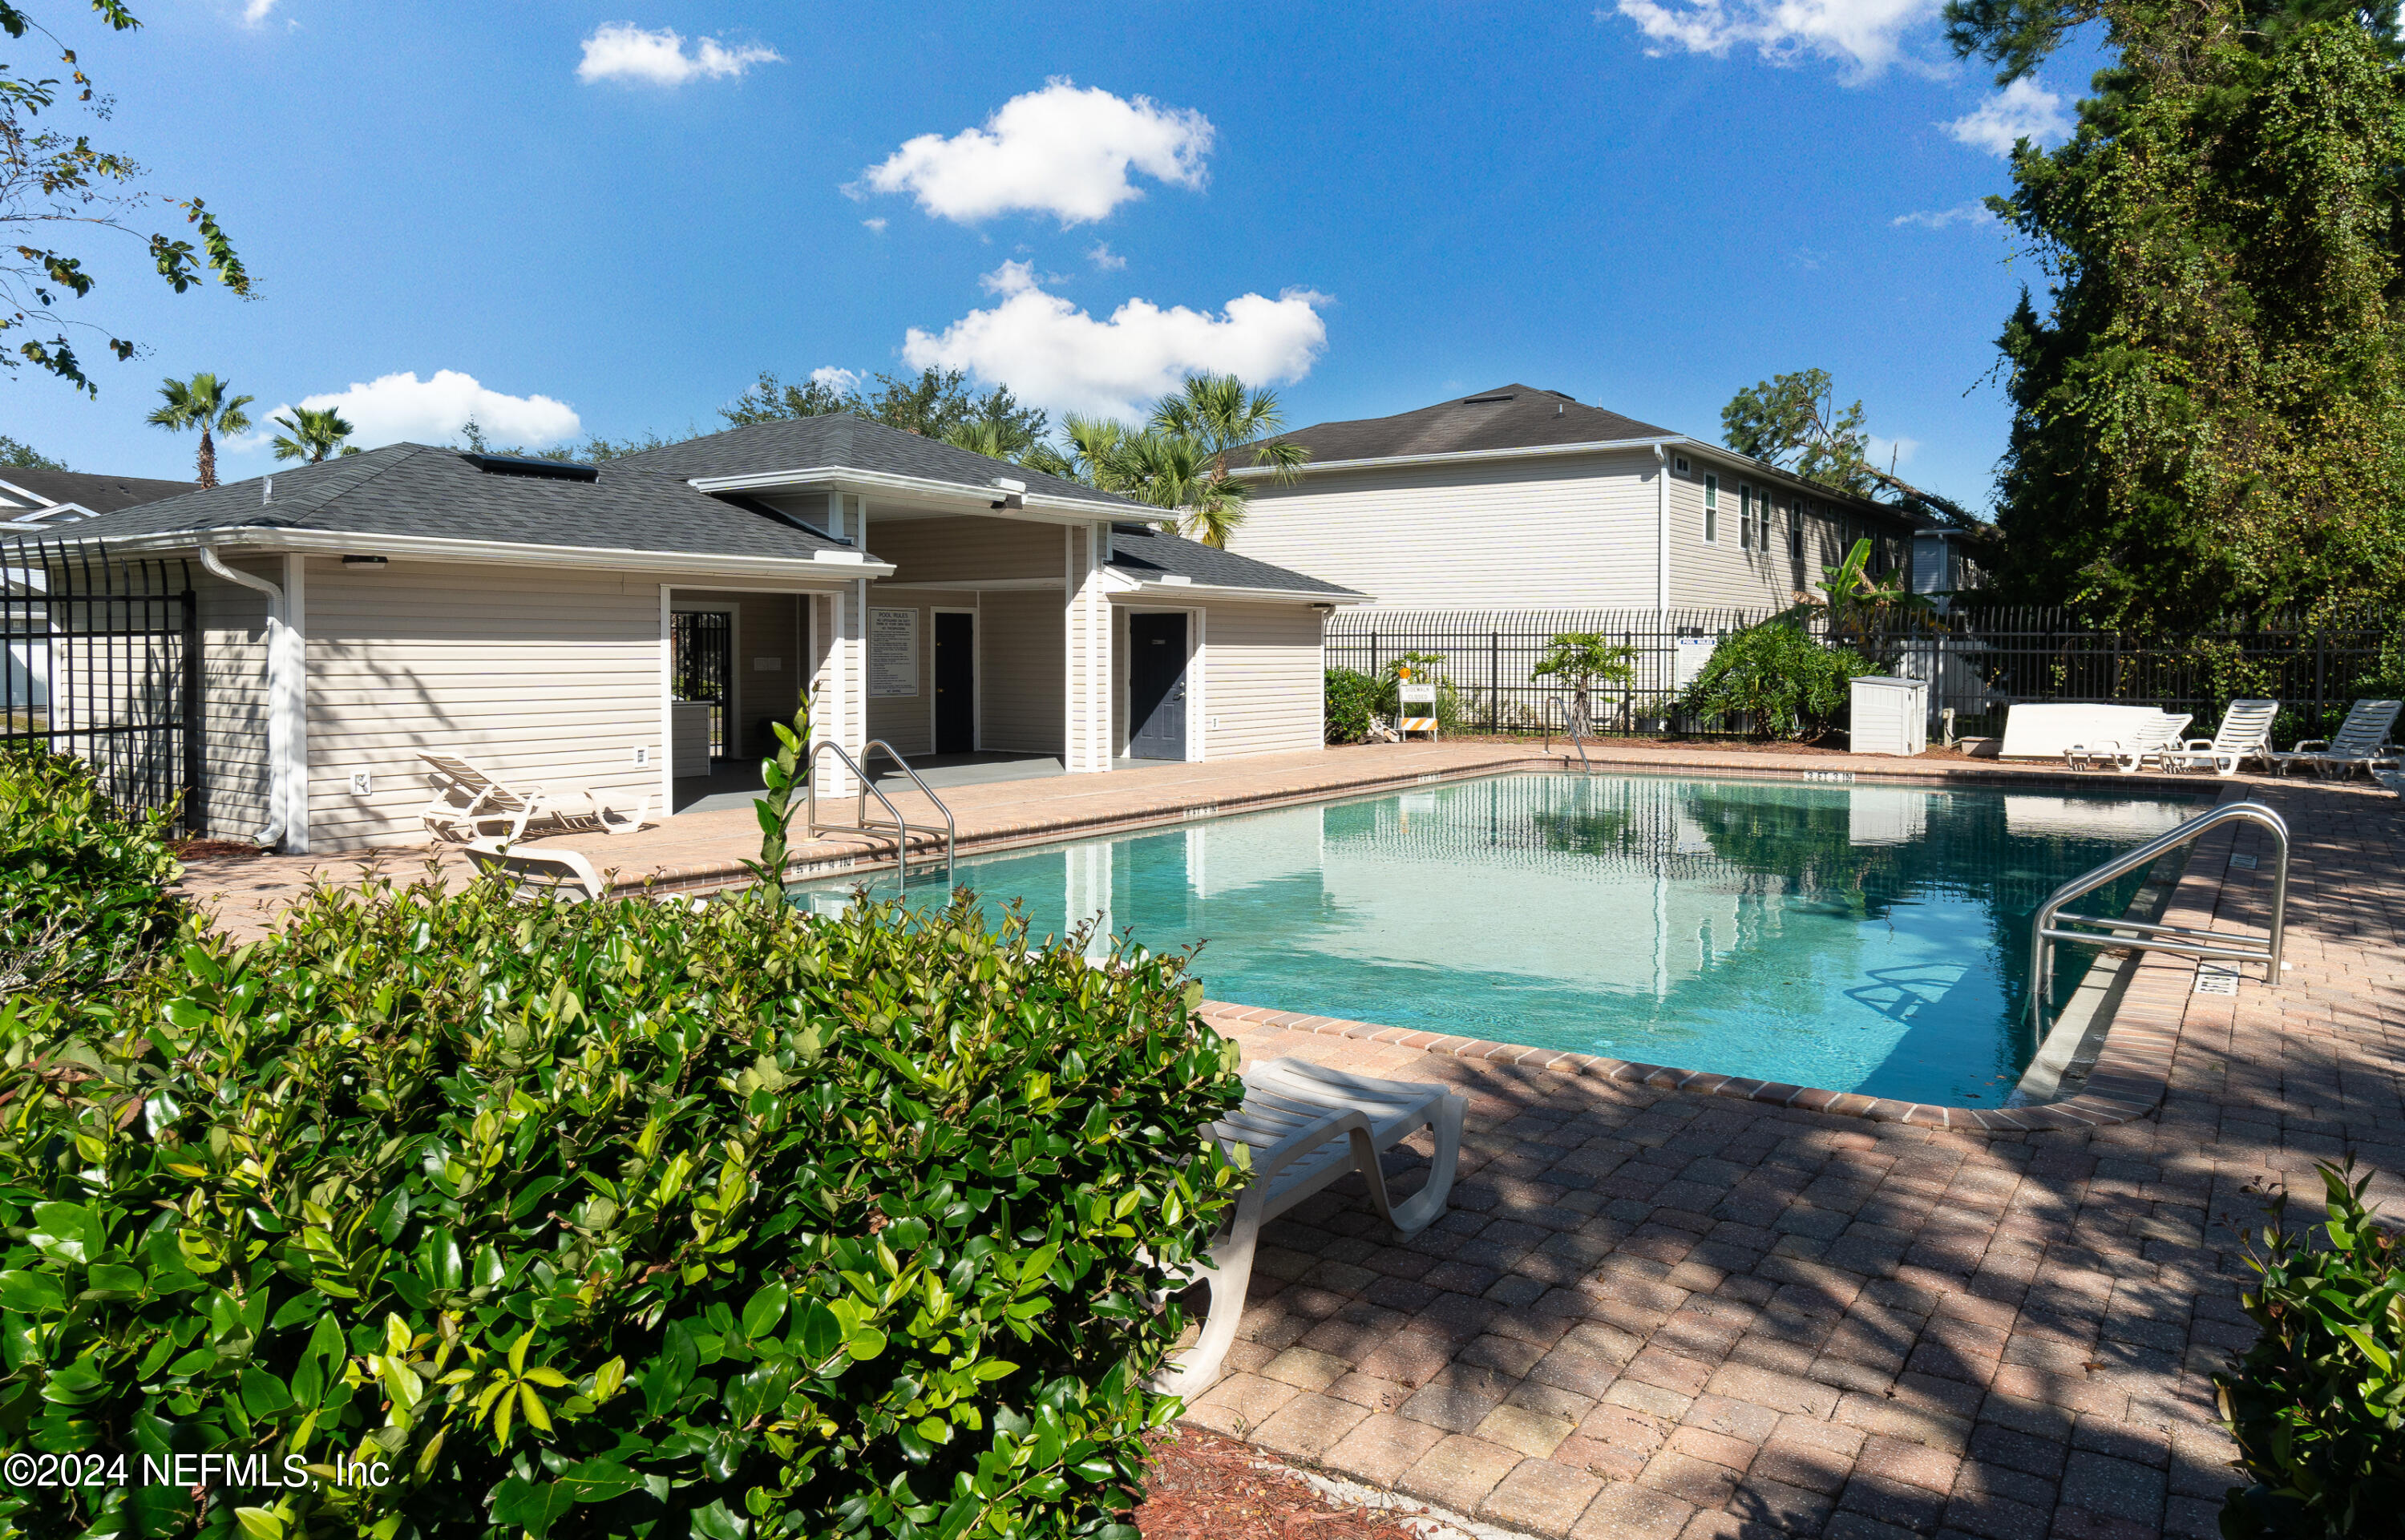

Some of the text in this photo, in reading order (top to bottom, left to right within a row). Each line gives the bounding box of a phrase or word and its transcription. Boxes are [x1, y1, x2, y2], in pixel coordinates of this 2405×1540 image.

[796, 863, 803, 874] 5
[809, 860, 823, 871] FT
[839, 856, 851, 867] IN
